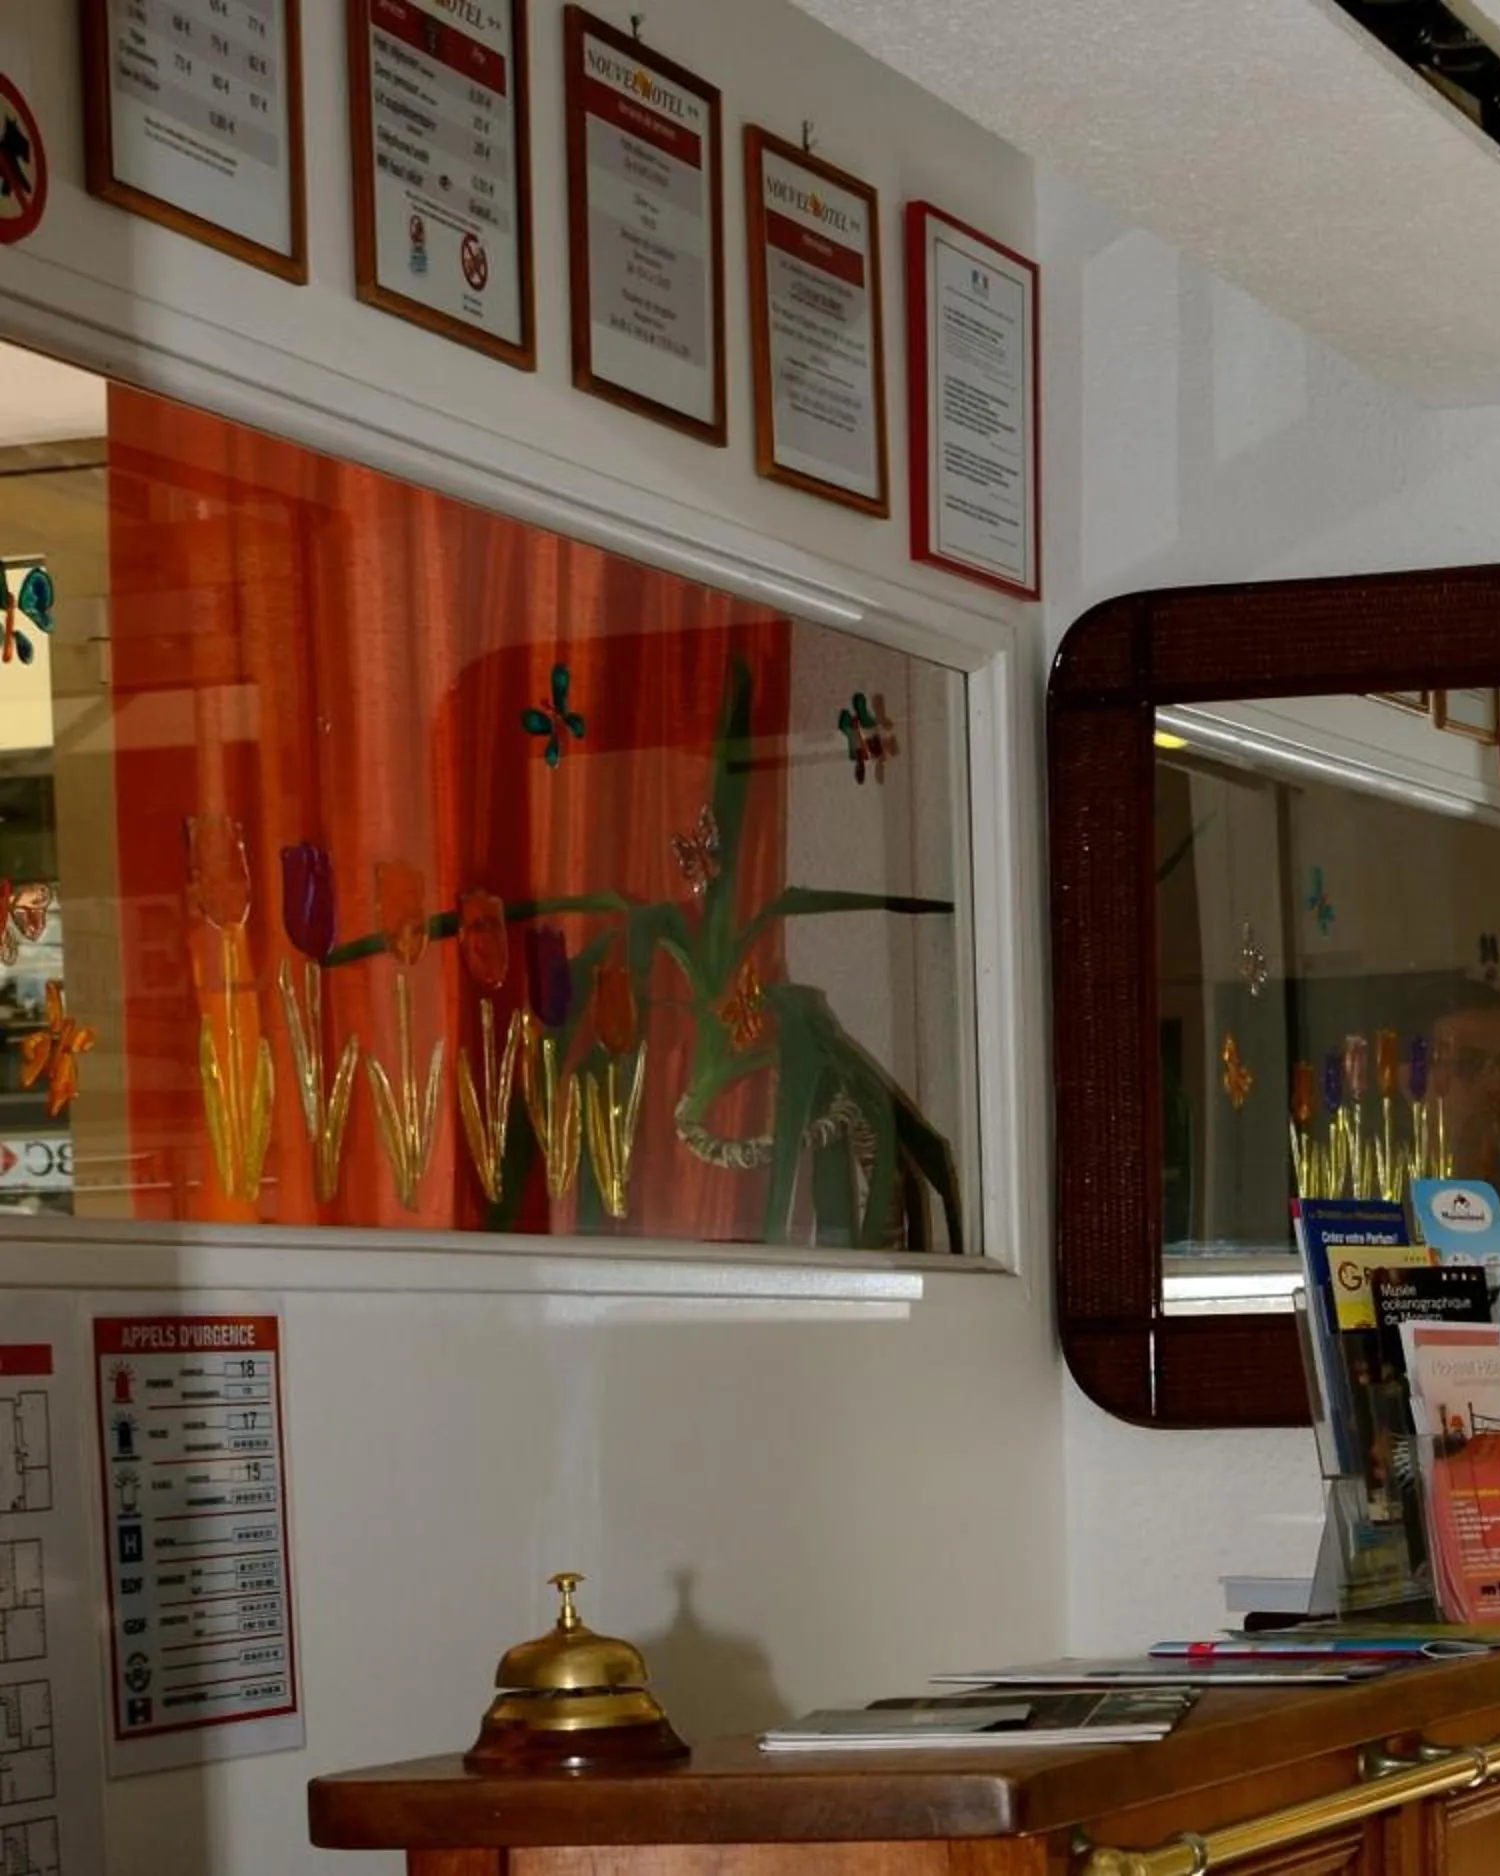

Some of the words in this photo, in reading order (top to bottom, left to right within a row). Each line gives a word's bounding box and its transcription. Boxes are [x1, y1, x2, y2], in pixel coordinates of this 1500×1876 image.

[1384, 1312, 1399, 1326] de
[121, 1326, 176, 1347] APPELS
[180, 1324, 256, 1347] D'URGENCE
[240, 1359, 256, 1378] 18
[242, 1411, 258, 1430] 17
